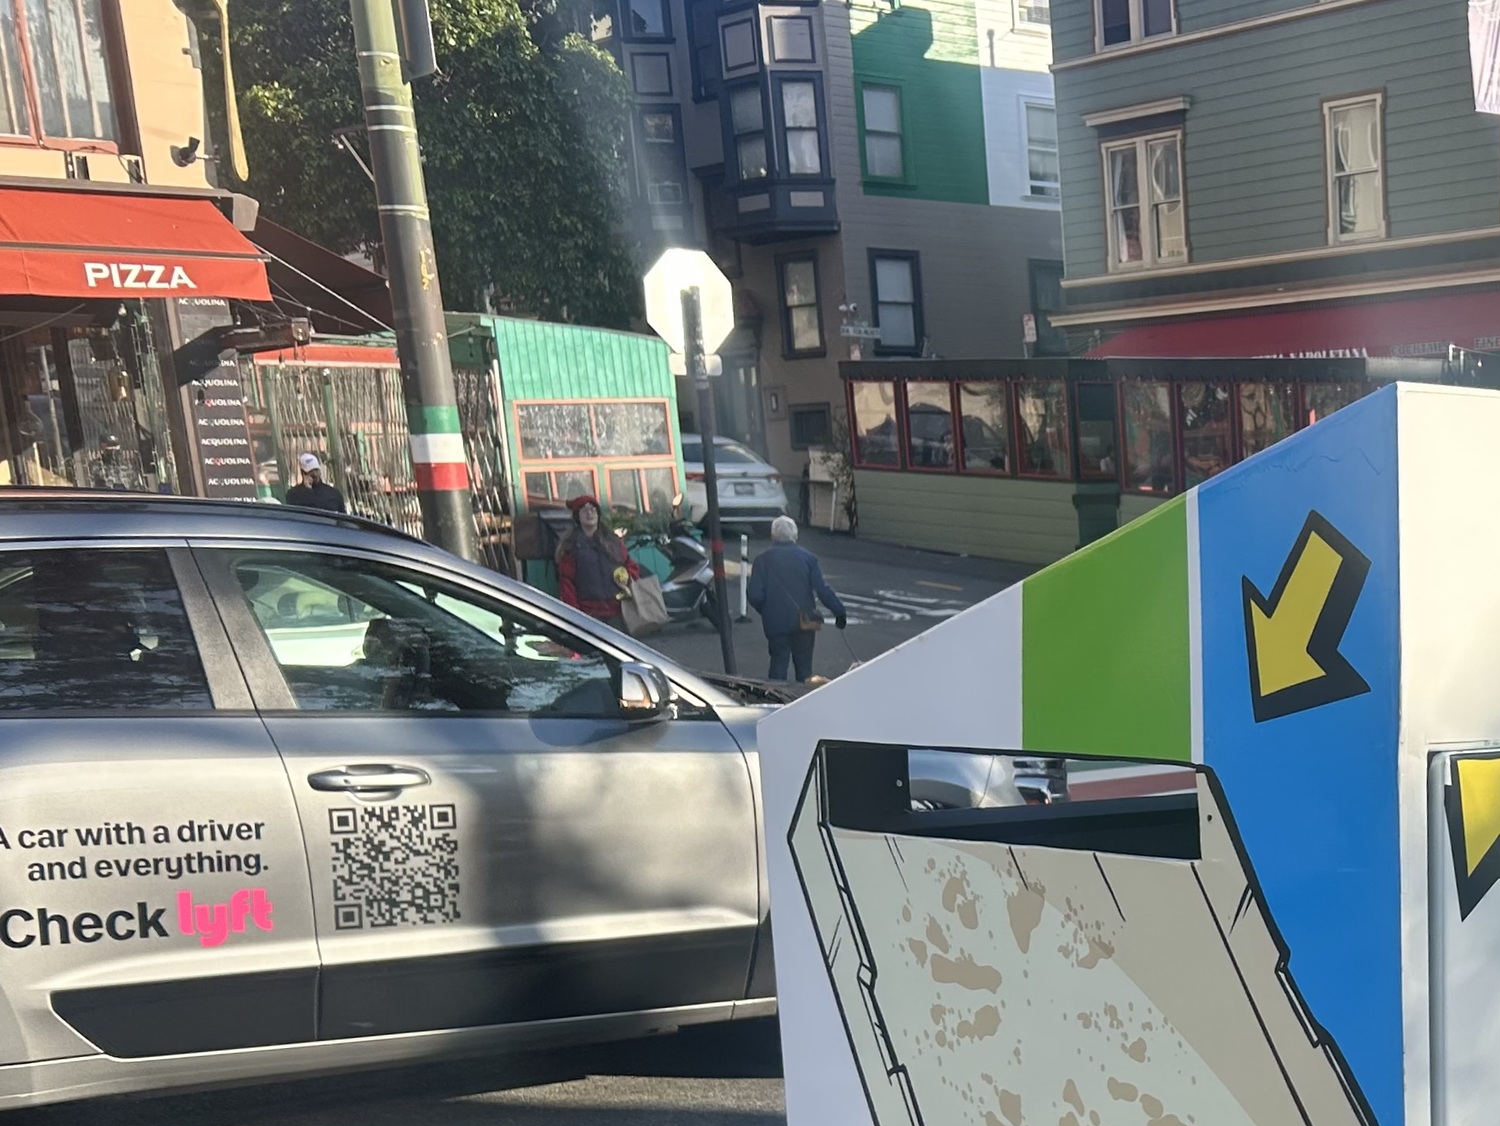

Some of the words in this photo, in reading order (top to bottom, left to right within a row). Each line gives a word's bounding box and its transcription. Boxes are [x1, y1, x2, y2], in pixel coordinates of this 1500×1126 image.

[83, 262, 198, 289] PIZZA
[195, 399, 241, 407] QUOLINA
[201, 438, 248, 447] ACQUOLINA
[204, 457, 251, 466] ACQUOLINA
[18, 828, 68, 849] car
[75, 821, 146, 847] with
[153, 826, 170, 844] a
[177, 819, 265, 843] driver
[28, 856, 87, 882] and
[94, 850, 269, 879] everything.
[0, 902, 170, 949] Check
[176, 887, 274, 948] lyft
